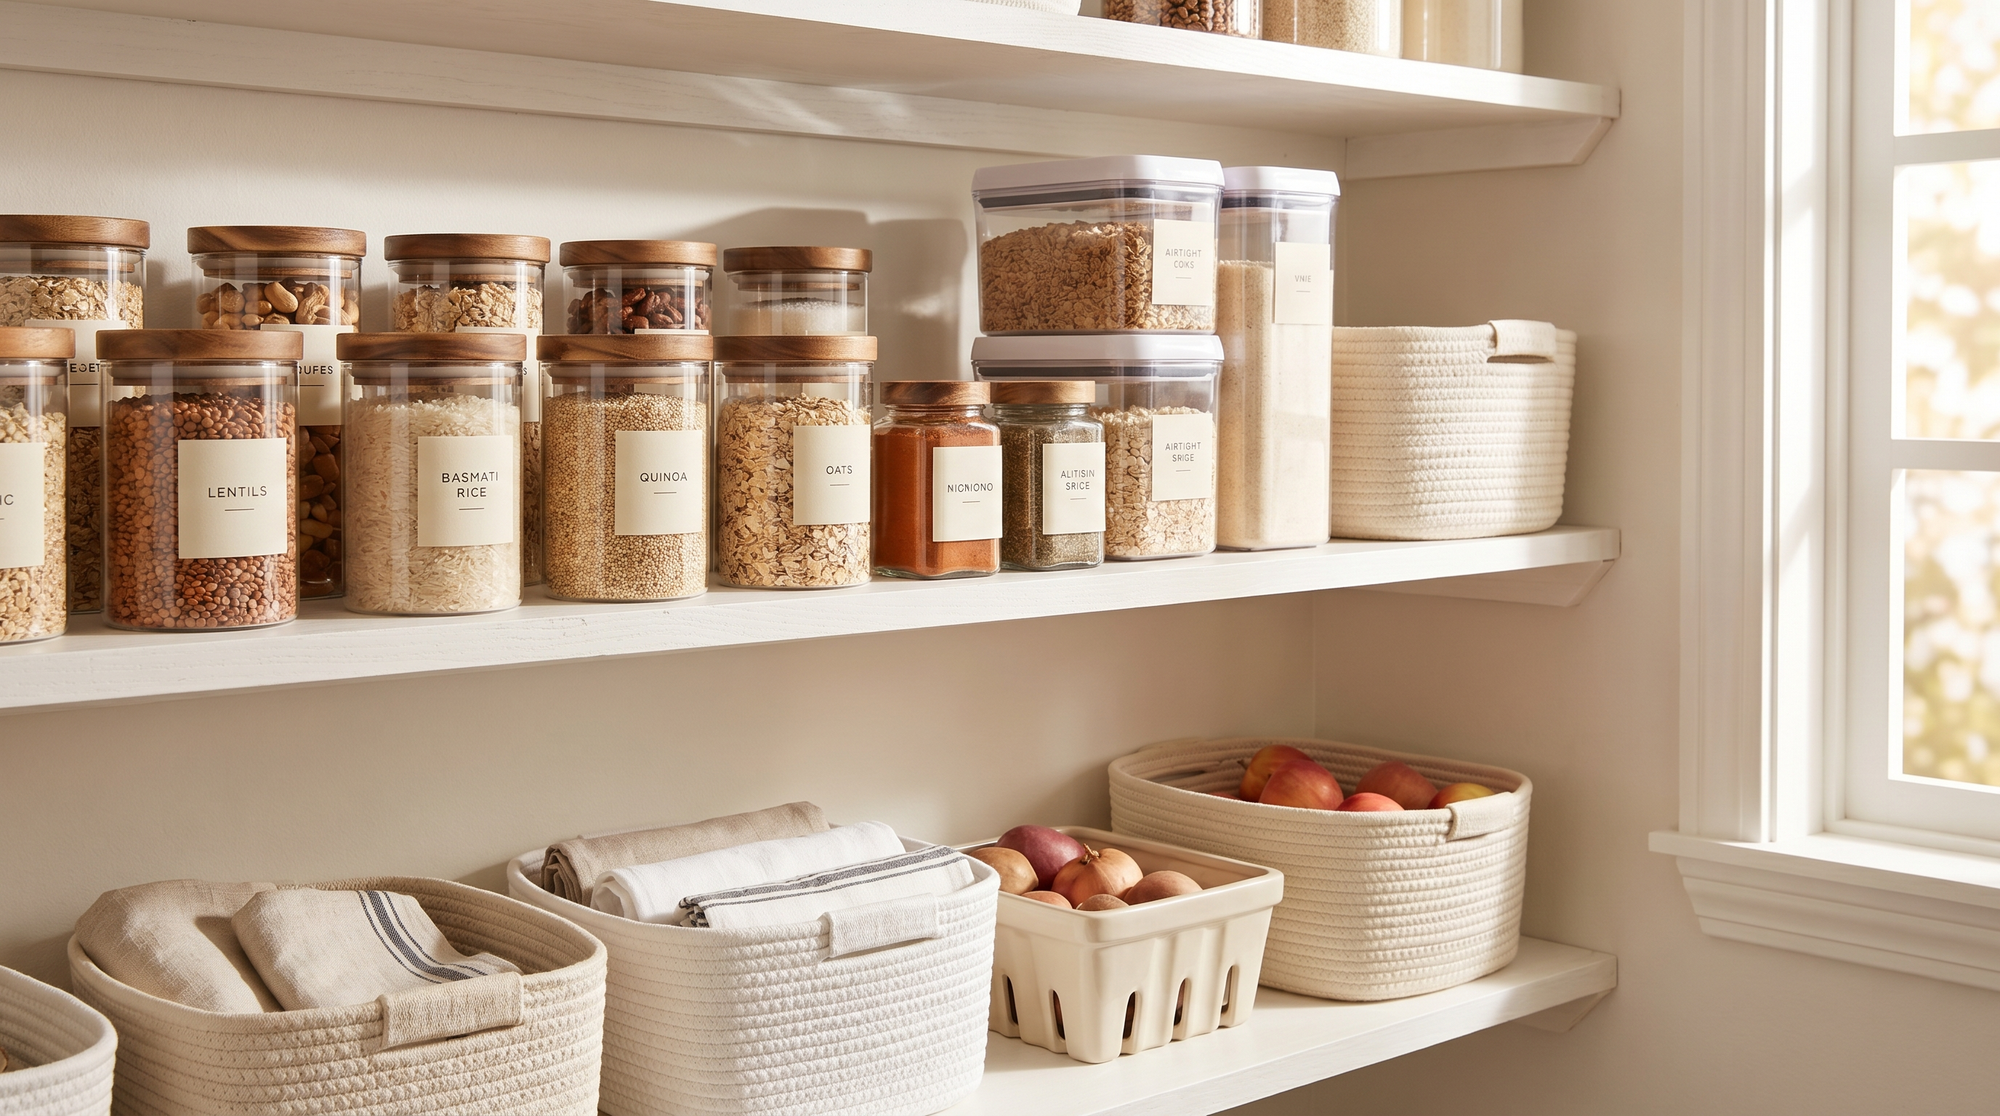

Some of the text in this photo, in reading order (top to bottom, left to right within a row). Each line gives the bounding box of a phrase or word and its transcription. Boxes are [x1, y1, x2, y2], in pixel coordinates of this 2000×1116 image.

[1165, 248, 1202, 258] AIRTIGHT
[1165, 441, 1202, 451] AIRTIGHT
[825, 464, 853, 475] OATS
[441, 471, 500, 484] BASMATI
[639, 472, 688, 484] QUINOA
[1065, 481, 1090, 491] SRICE
[208, 486, 267, 498] LENTILS
[456, 487, 488, 499] RICE
